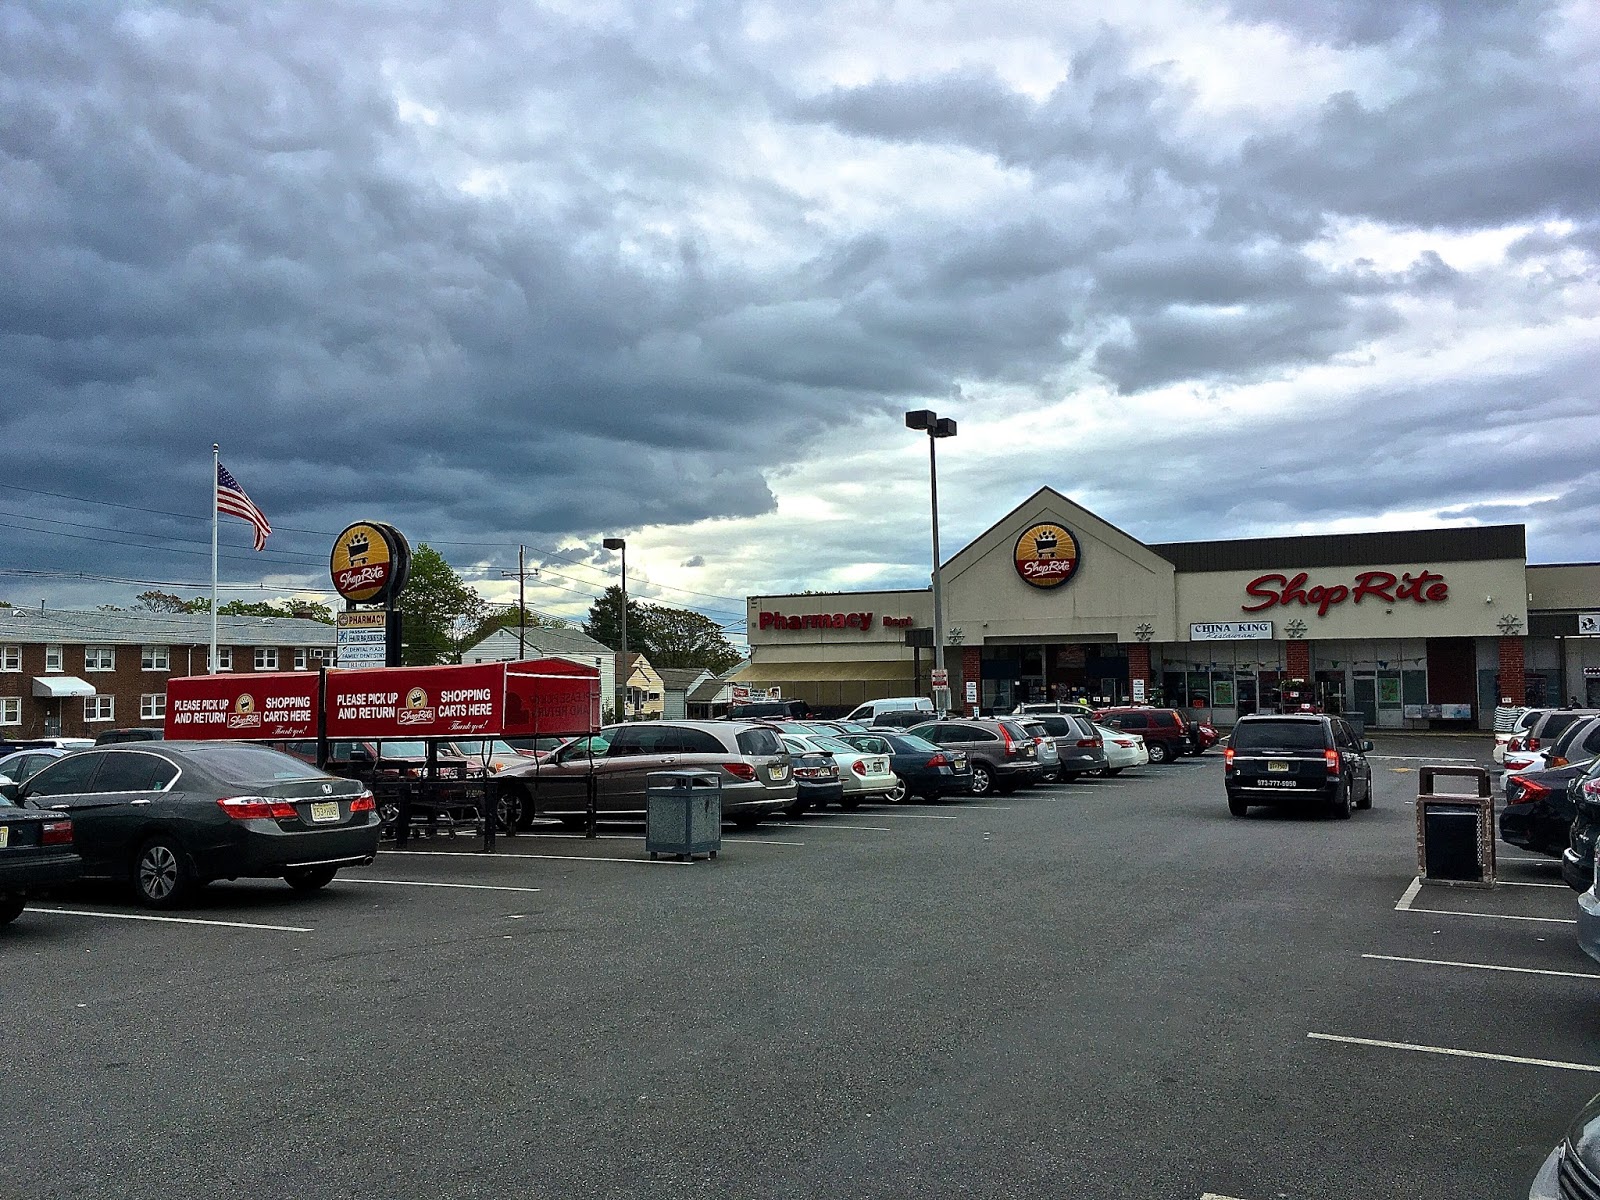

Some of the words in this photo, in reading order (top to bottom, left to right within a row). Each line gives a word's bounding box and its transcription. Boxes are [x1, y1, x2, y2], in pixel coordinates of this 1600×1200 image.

[1024, 560, 1070, 577] ShopRite
[340, 565, 384, 590] ShopRite
[1241, 570, 1449, 616] ShopRite
[349, 614, 385, 625] PHARMACY
[759, 612, 873, 631] Pharmacy
[883, 615, 913, 628] Dept
[1195, 624, 1231, 633] CHINA
[1238, 623, 1268, 632] KING
[266, 696, 311, 708] SHOPPING
[337, 693, 366, 706] PLEASE
[368, 692, 386, 705] PICK
[387, 692, 399, 704] UP
[441, 688, 491, 703] SHOPPING
[174, 700, 201, 711] PLEASE
[202, 699, 217, 710] PICK
[219, 699, 229, 710] UP
[438, 704, 467, 717] CARTS
[468, 703, 493, 716] HERE
[174, 712, 192, 724] AND
[193, 712, 227, 724] RETURN
[263, 710, 289, 722] CARTS
[290, 710, 311, 721] HERE
[338, 707, 357, 720] AND
[359, 706, 396, 719] RETURN
[399, 709, 434, 724] ShopRite
[229, 714, 260, 728] ShopRite
[448, 720, 471, 731] Thank
[471, 719, 489, 733] you!
[272, 725, 292, 735] Thank
[292, 725, 308, 737] you!
